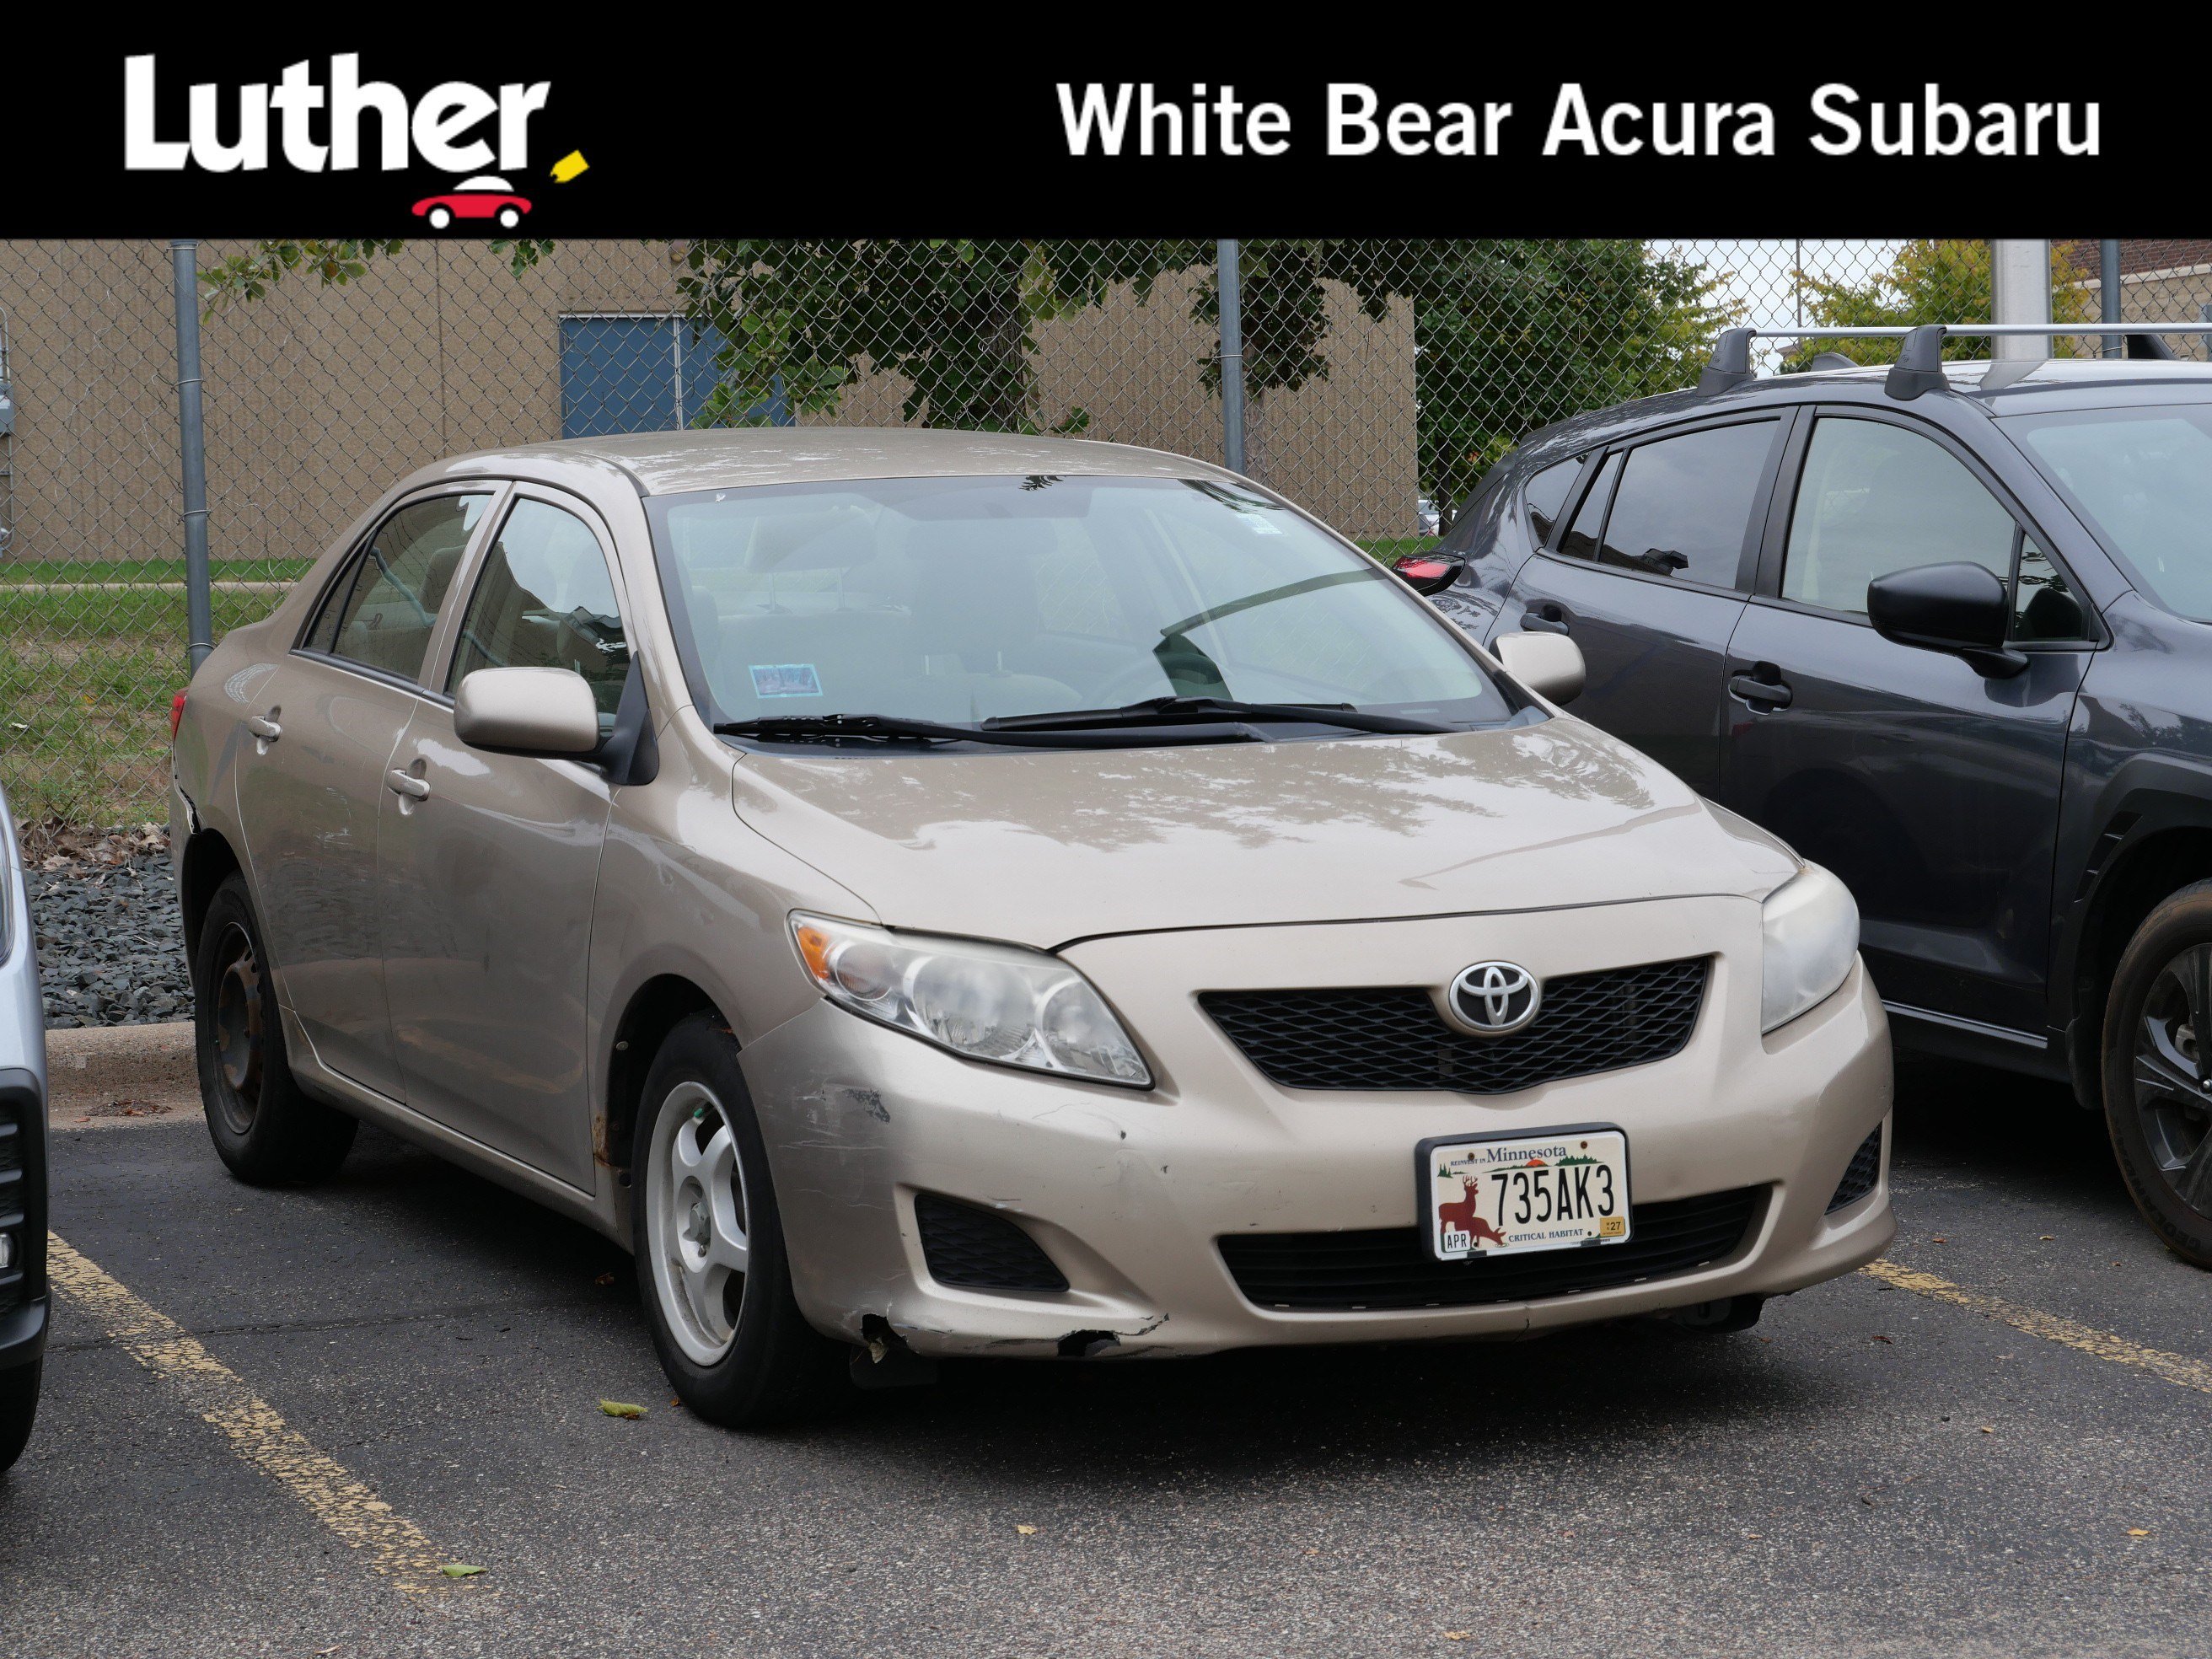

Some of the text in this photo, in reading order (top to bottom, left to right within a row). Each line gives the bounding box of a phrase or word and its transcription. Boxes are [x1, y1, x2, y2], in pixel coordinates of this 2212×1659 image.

[1450, 1158, 1478, 1167] REINVEST
[1486, 1146, 1567, 1163] Minnesota
[1491, 1164, 1614, 1227] 735AK3
[1610, 1221, 1621, 1231] 27
[1447, 1233, 1468, 1249] APR
[1508, 1229, 1583, 1243] CRITICAL HABITAT
